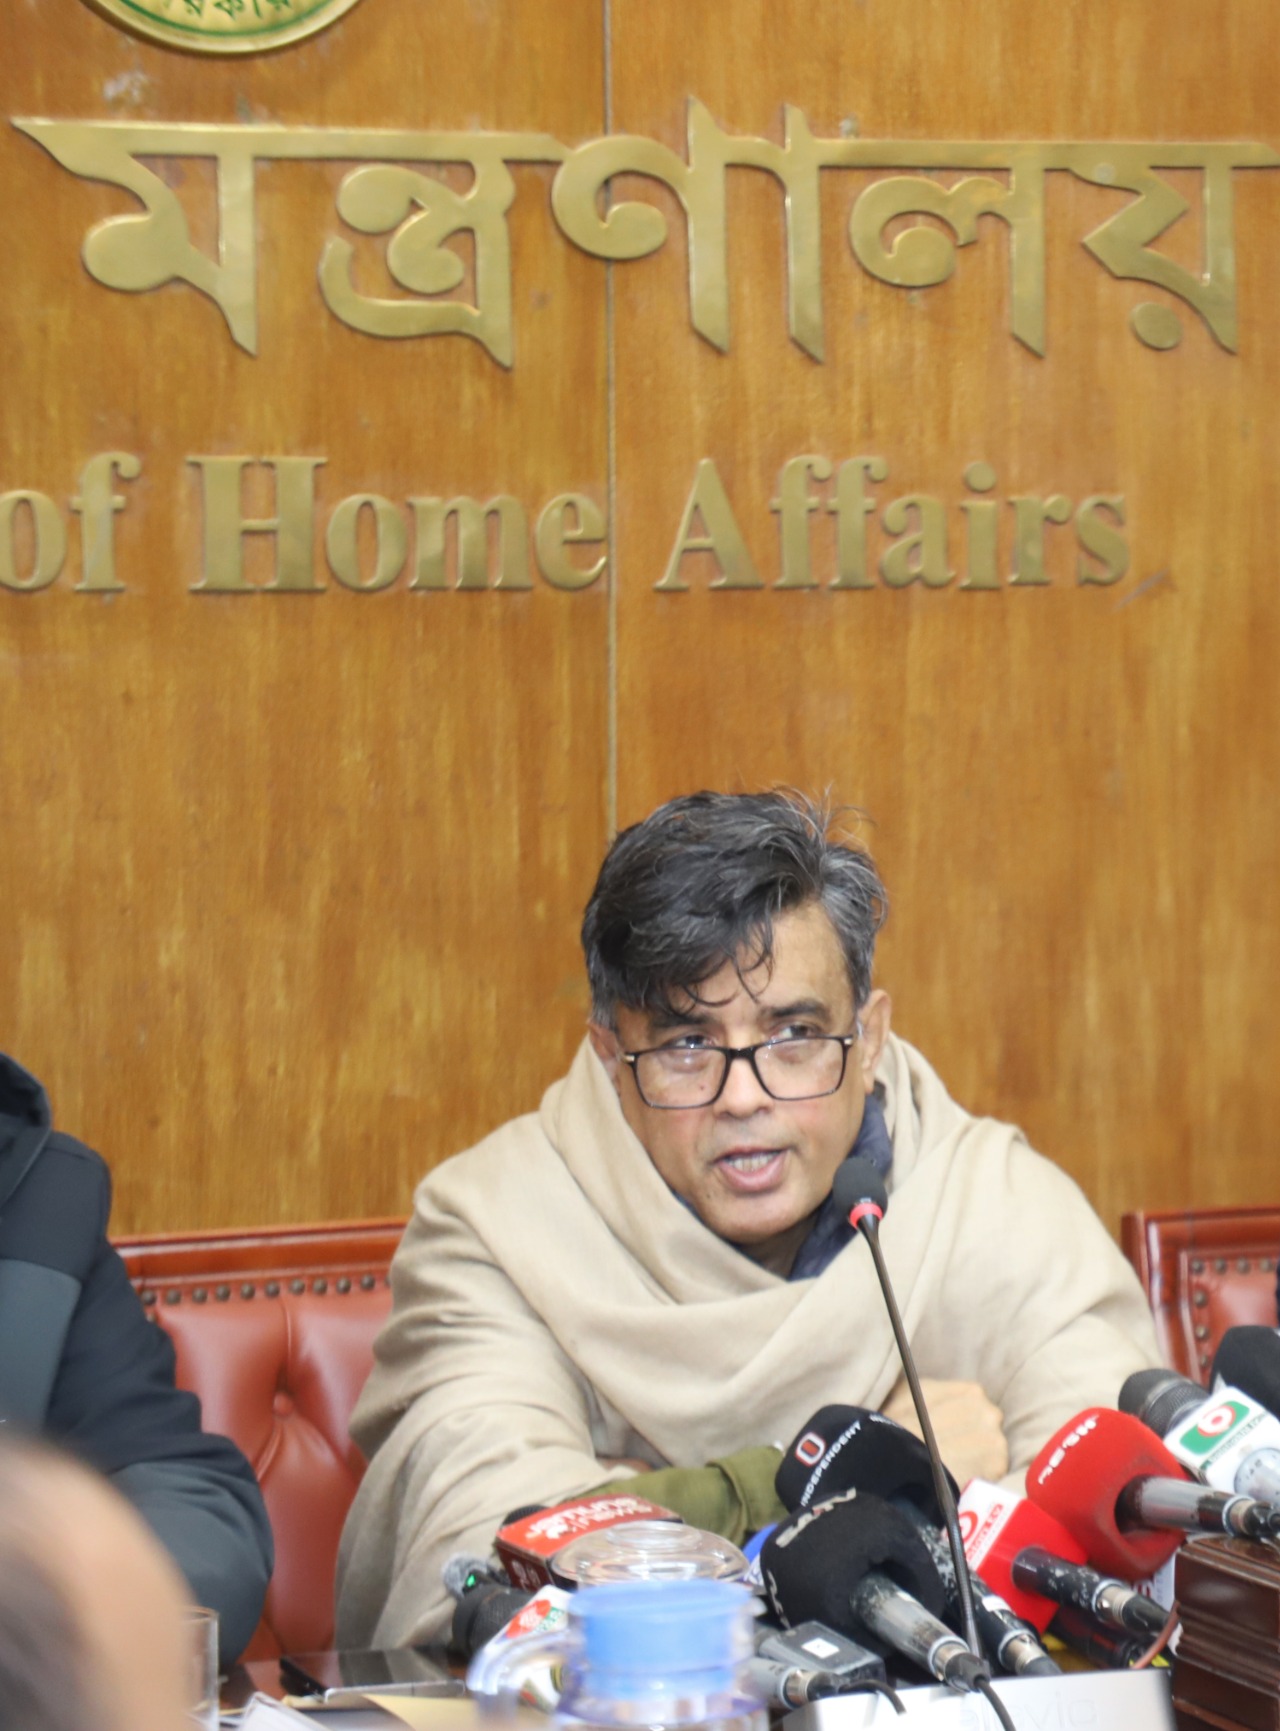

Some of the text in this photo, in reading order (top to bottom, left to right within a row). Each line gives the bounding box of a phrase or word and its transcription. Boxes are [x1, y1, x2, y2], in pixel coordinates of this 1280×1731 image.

[0, 452, 1131, 591] of Home Affairs
[800, 1420, 862, 1508] INDEPENDENT
